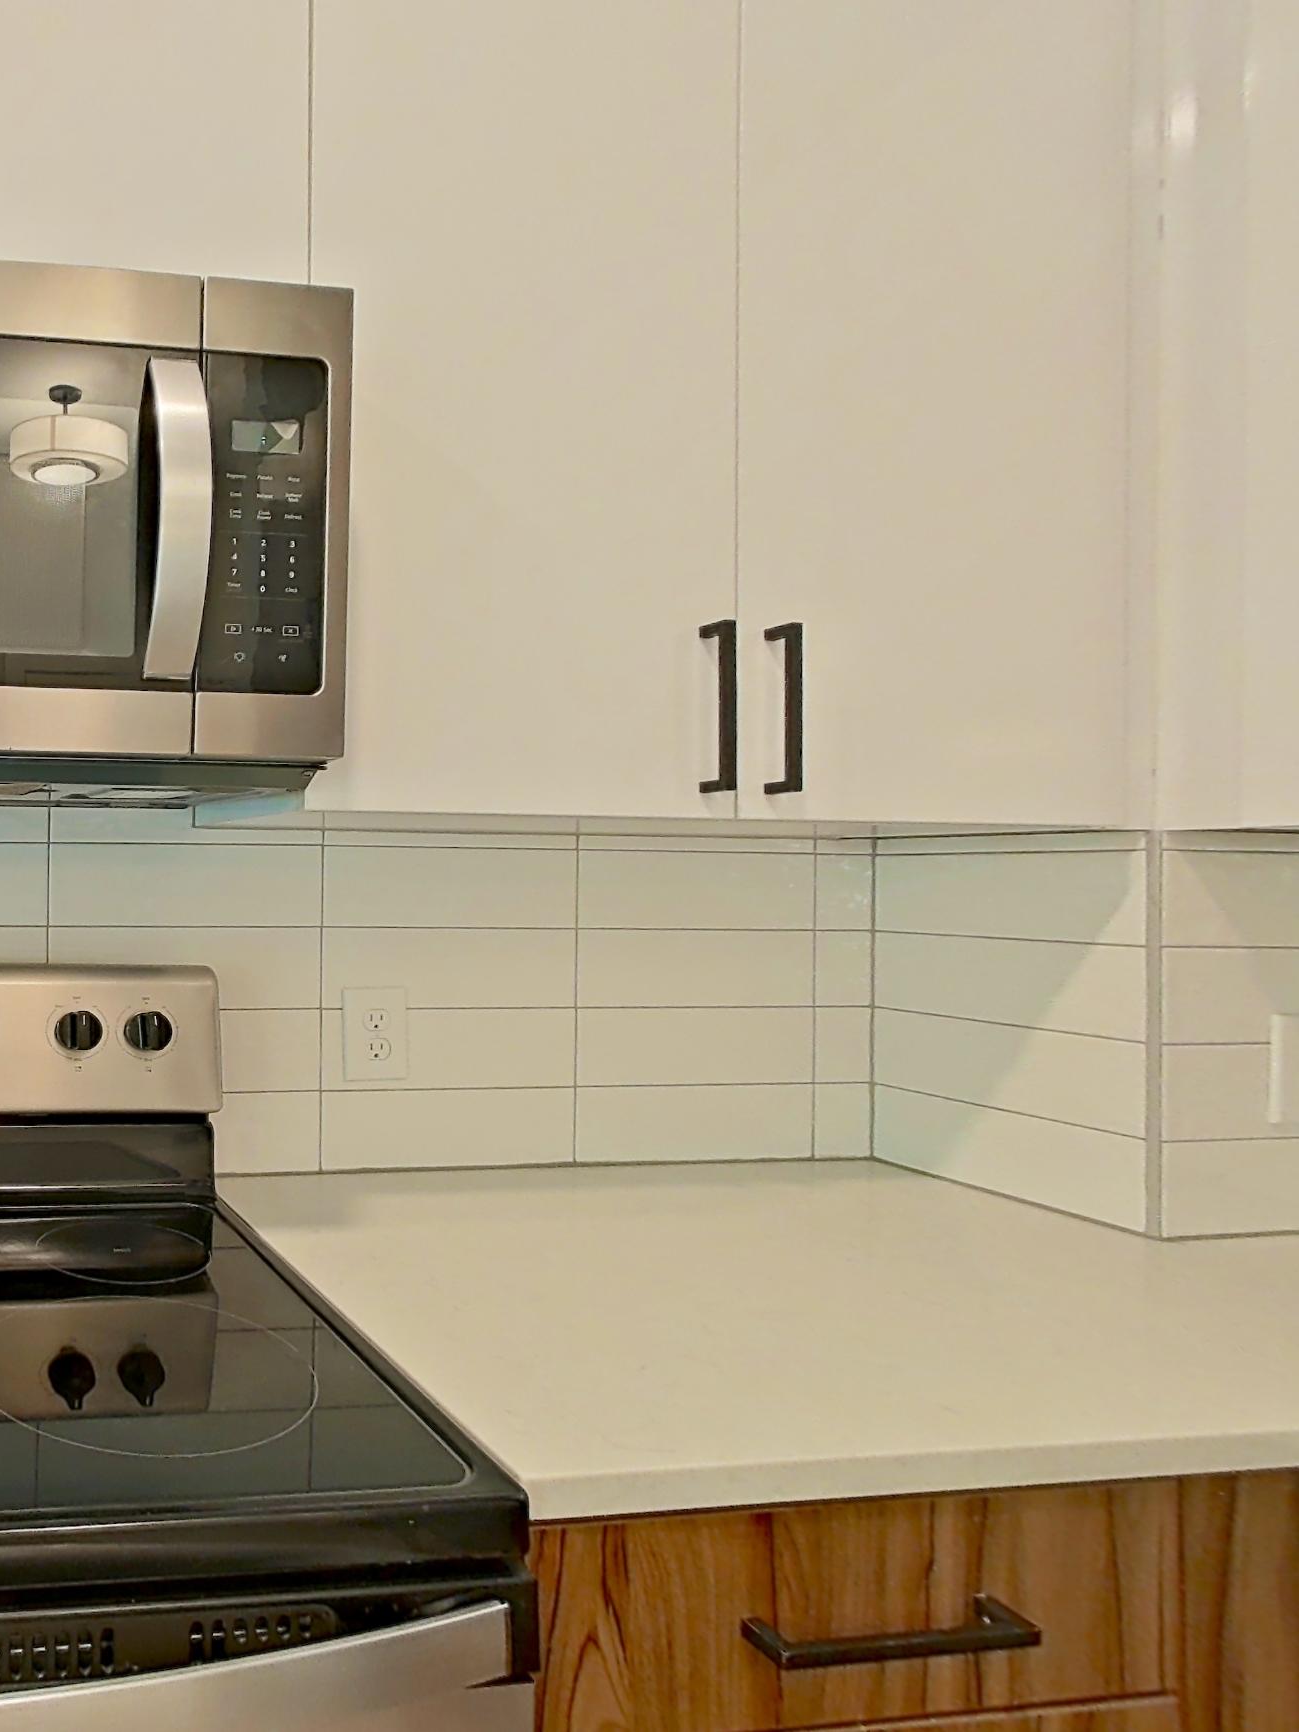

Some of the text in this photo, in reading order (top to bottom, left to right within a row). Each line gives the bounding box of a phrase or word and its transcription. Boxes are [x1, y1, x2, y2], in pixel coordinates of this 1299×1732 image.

[260, 539, 267, 547] 2
[288, 540, 295, 549] 3
[260, 554, 267, 562] 5
[232, 568, 238, 576] 7
[260, 585, 267, 594] 0
